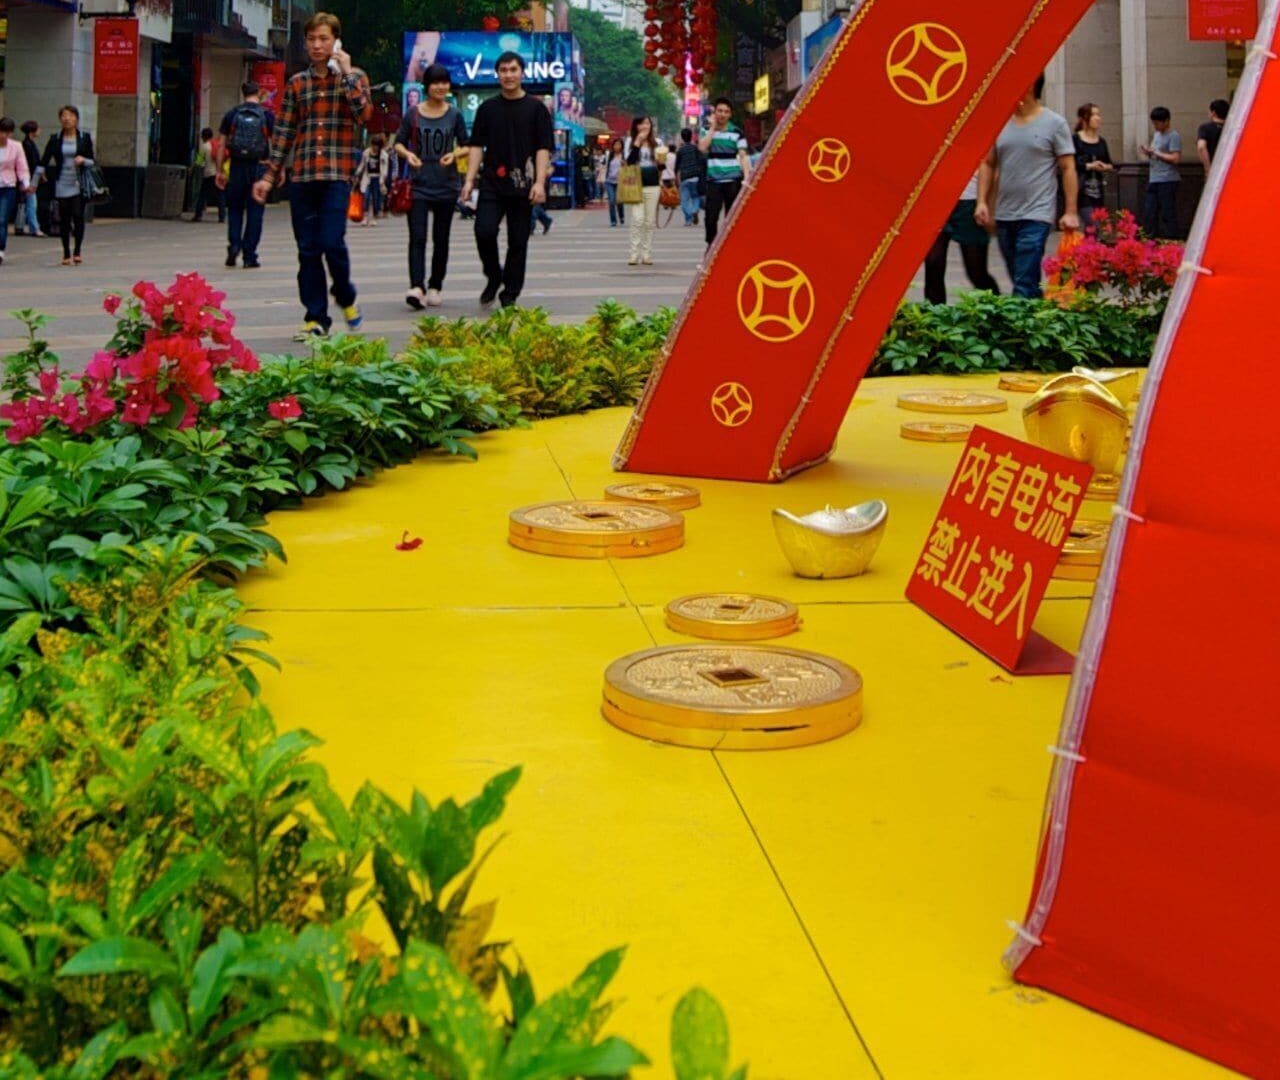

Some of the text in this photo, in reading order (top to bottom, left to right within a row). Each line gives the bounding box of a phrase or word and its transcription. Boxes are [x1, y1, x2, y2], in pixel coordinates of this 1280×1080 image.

[951, 442, 1082, 548] 内有电流
[916, 517, 1033, 641] 禁止进入
